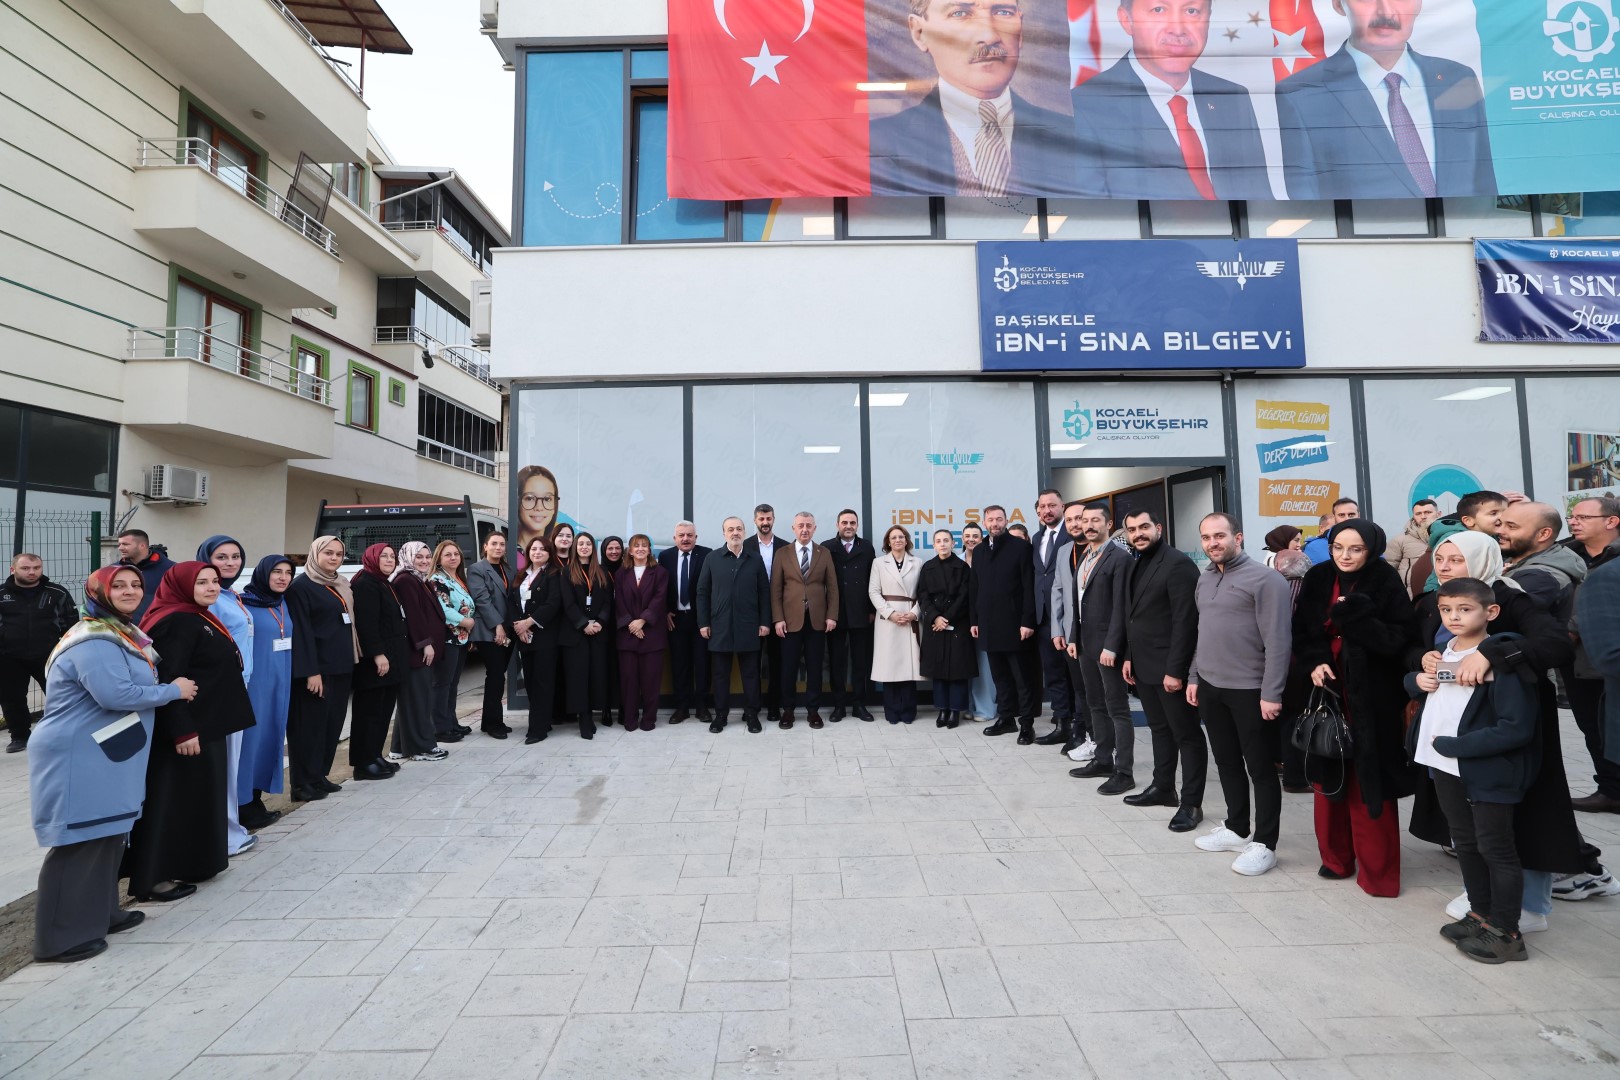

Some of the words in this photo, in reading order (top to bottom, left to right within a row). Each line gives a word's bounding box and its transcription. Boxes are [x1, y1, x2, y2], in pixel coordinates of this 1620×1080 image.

[1539, 110, 1596, 120] ÇALIŞINCA
[1561, 250, 1609, 258] KOCAELİ
[1218, 261, 1267, 276] KILAVUZ
[1020, 272, 1085, 280] BÜYÜKŞEHİR
[1569, 275, 1620, 297] SİN
[995, 315, 1096, 328] BAŞİSKELE
[1080, 332, 1151, 352] SİNA
[1163, 331, 1292, 351] BİLGİEVİ
[1096, 408, 1159, 417] KOCAELİ
[1096, 418, 1208, 431] BÜYÜKŞEHİR
[940, 453, 972, 464] KILAVUZ
[1264, 448, 1288, 464] DERS
